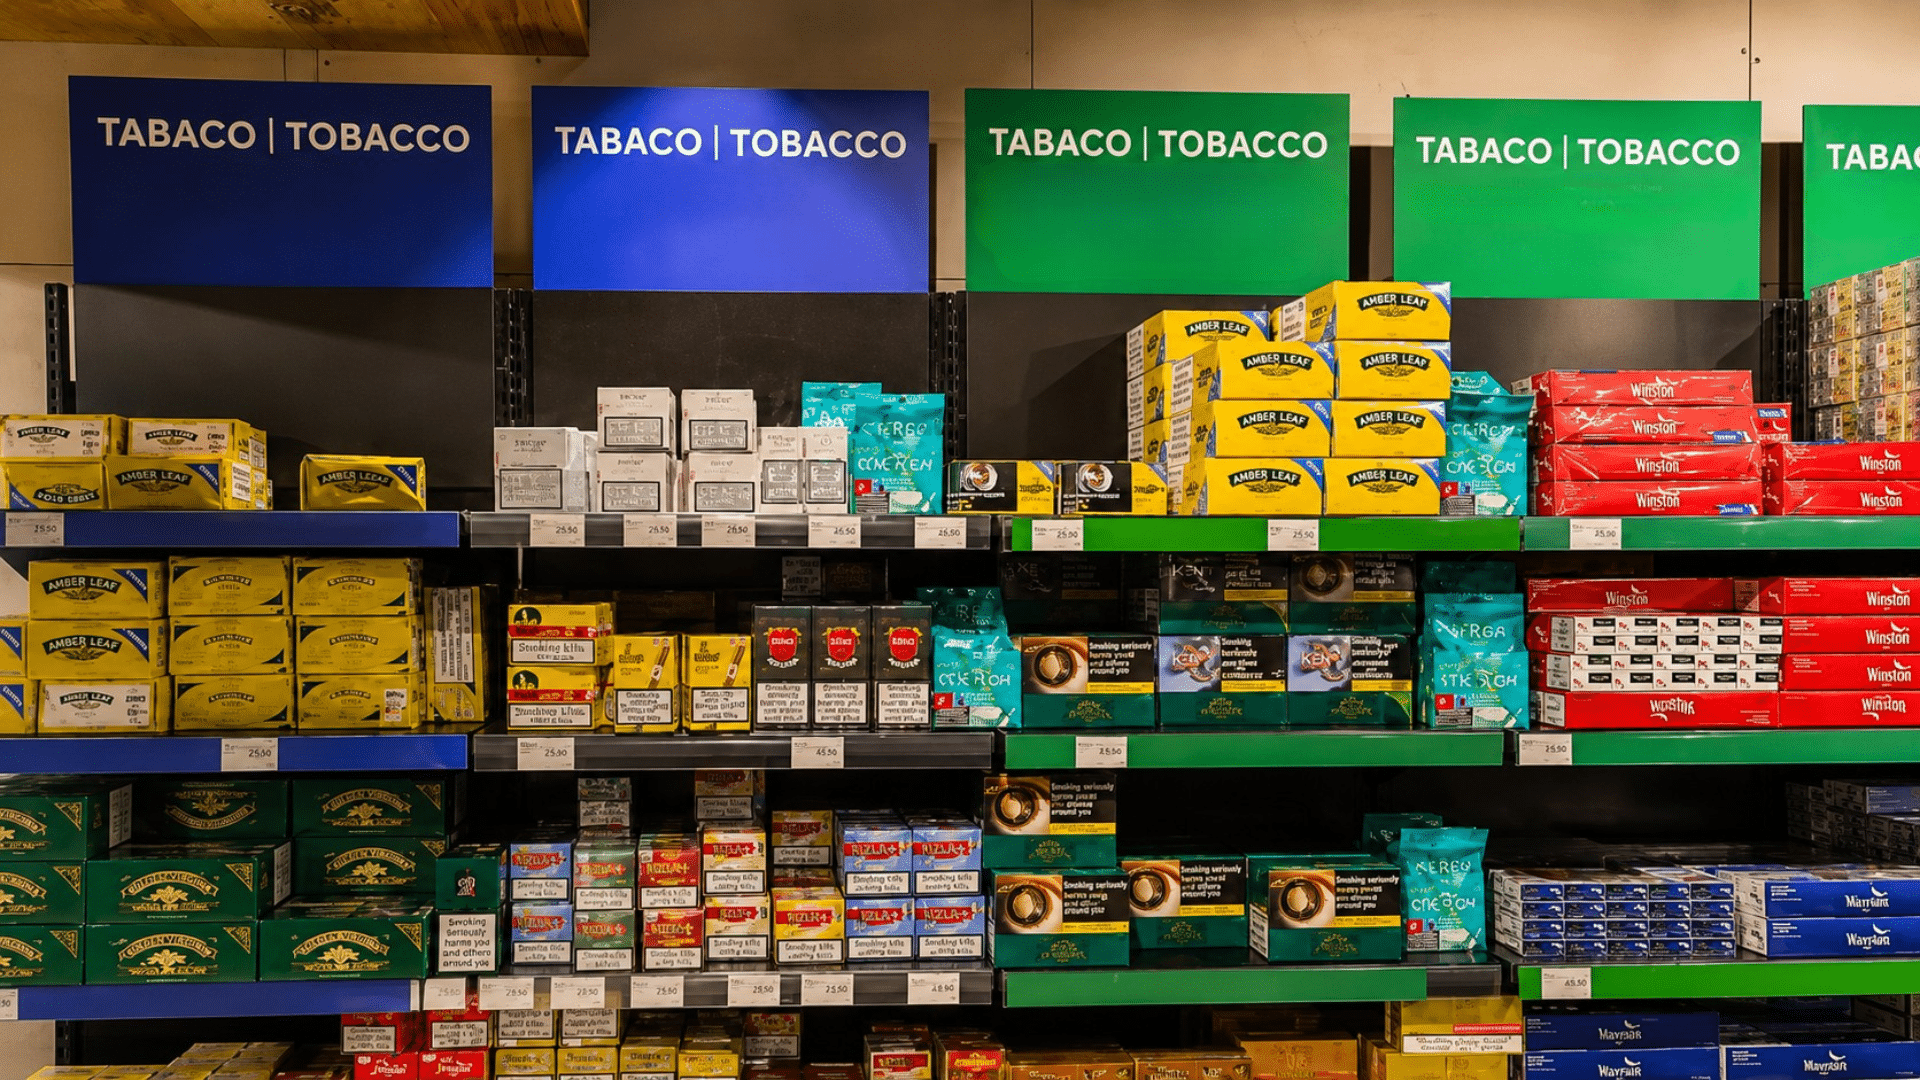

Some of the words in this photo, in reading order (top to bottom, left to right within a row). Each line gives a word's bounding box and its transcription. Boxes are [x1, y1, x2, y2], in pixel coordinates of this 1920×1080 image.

[97, 116, 256, 150] TABACO
[285, 121, 470, 154] TOBACCO
[554, 126, 703, 157] TABACO
[729, 128, 907, 159] TOBACCO
[988, 127, 1132, 158] TABACO
[1157, 129, 1329, 160] TOBACCO
[1415, 135, 1553, 165] TABACO
[1576, 137, 1741, 168] TOBACCO
[1222, 322, 1248, 335] LEAF
[1245, 354, 1280, 368] AMBER
[1284, 354, 1311, 367] LEAF
[1279, 413, 1307, 426] LEAF
[1359, 412, 1393, 426] AMBER
[1397, 413, 1423, 426] LEAF
[1635, 456, 1680, 474] Winston
[1859, 454, 1903, 472] Winston
[1233, 470, 1268, 484] AMBER
[1271, 470, 1299, 484] LEAF
[1352, 470, 1387, 484] AMBER
[1391, 470, 1418, 484] LEAF
[1635, 492, 1680, 509] Winston
[1859, 491, 1904, 508] Winston
[48, 576, 86, 592] AMBER
[90, 578, 118, 592] LEAF
[1605, 588, 1649, 606] Winston
[1865, 589, 1911, 607] Winston
[49, 636, 87, 652] AMBER
[90, 636, 119, 650] LEAF
[1865, 627, 1911, 645] Winston
[1866, 665, 1912, 683] Winston
